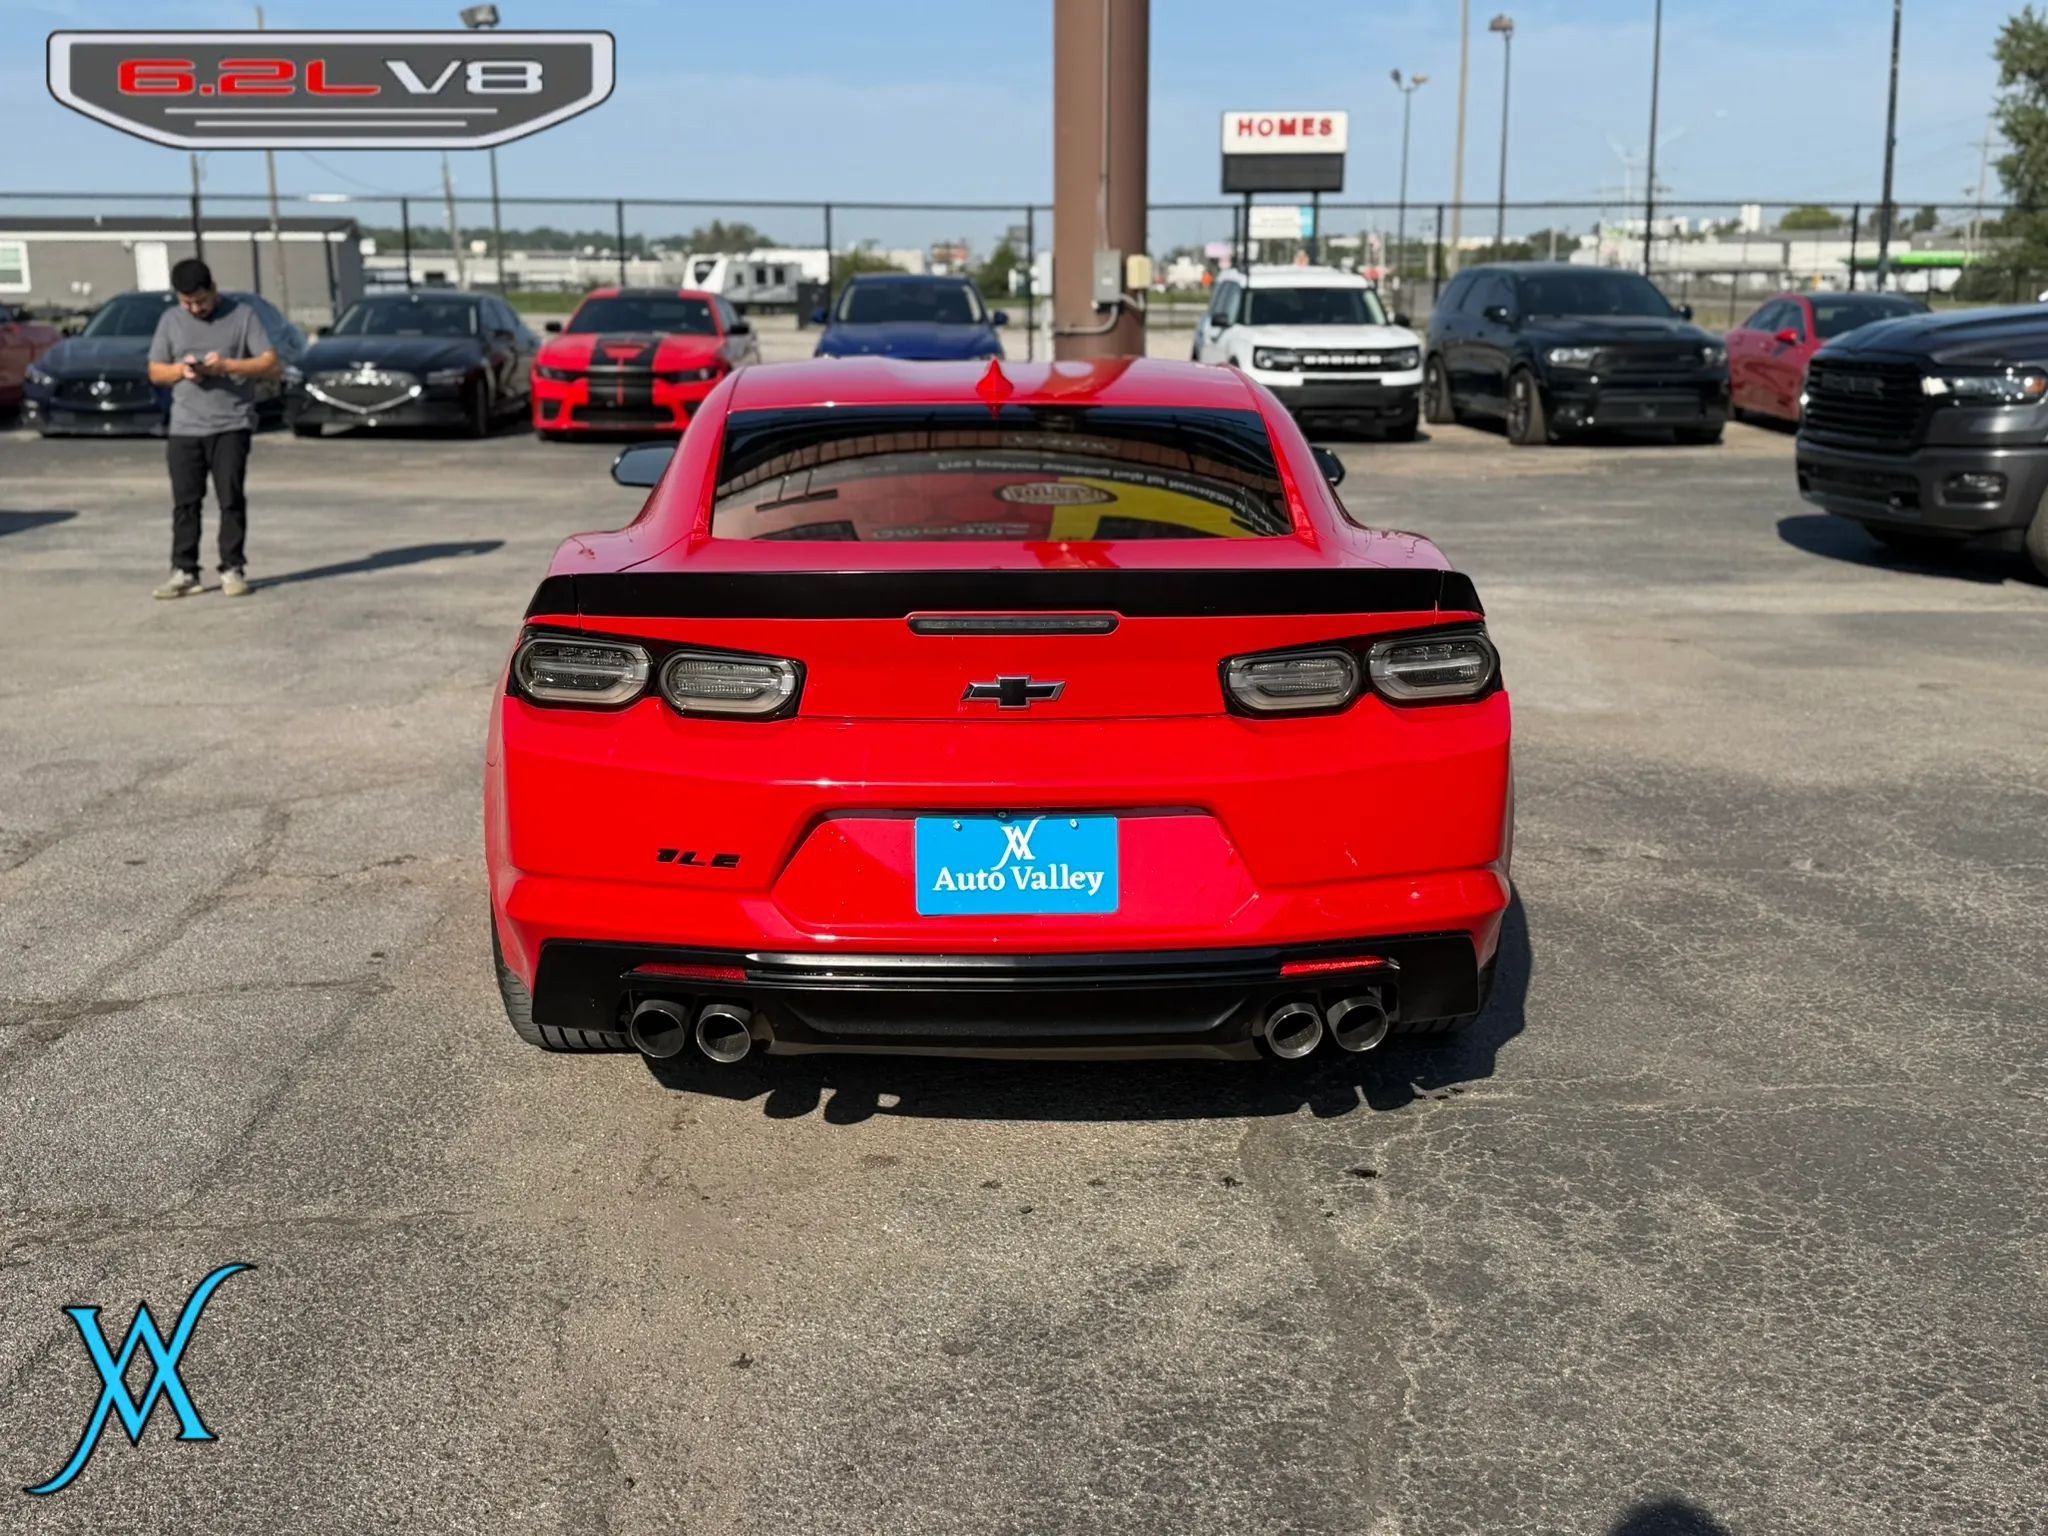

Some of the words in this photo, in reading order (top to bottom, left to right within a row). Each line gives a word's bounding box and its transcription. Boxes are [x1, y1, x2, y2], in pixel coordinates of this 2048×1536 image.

[1237, 117, 1333, 137] HOMES
[932, 866, 1006, 892] Auto
[1010, 863, 1105, 896] Valley
